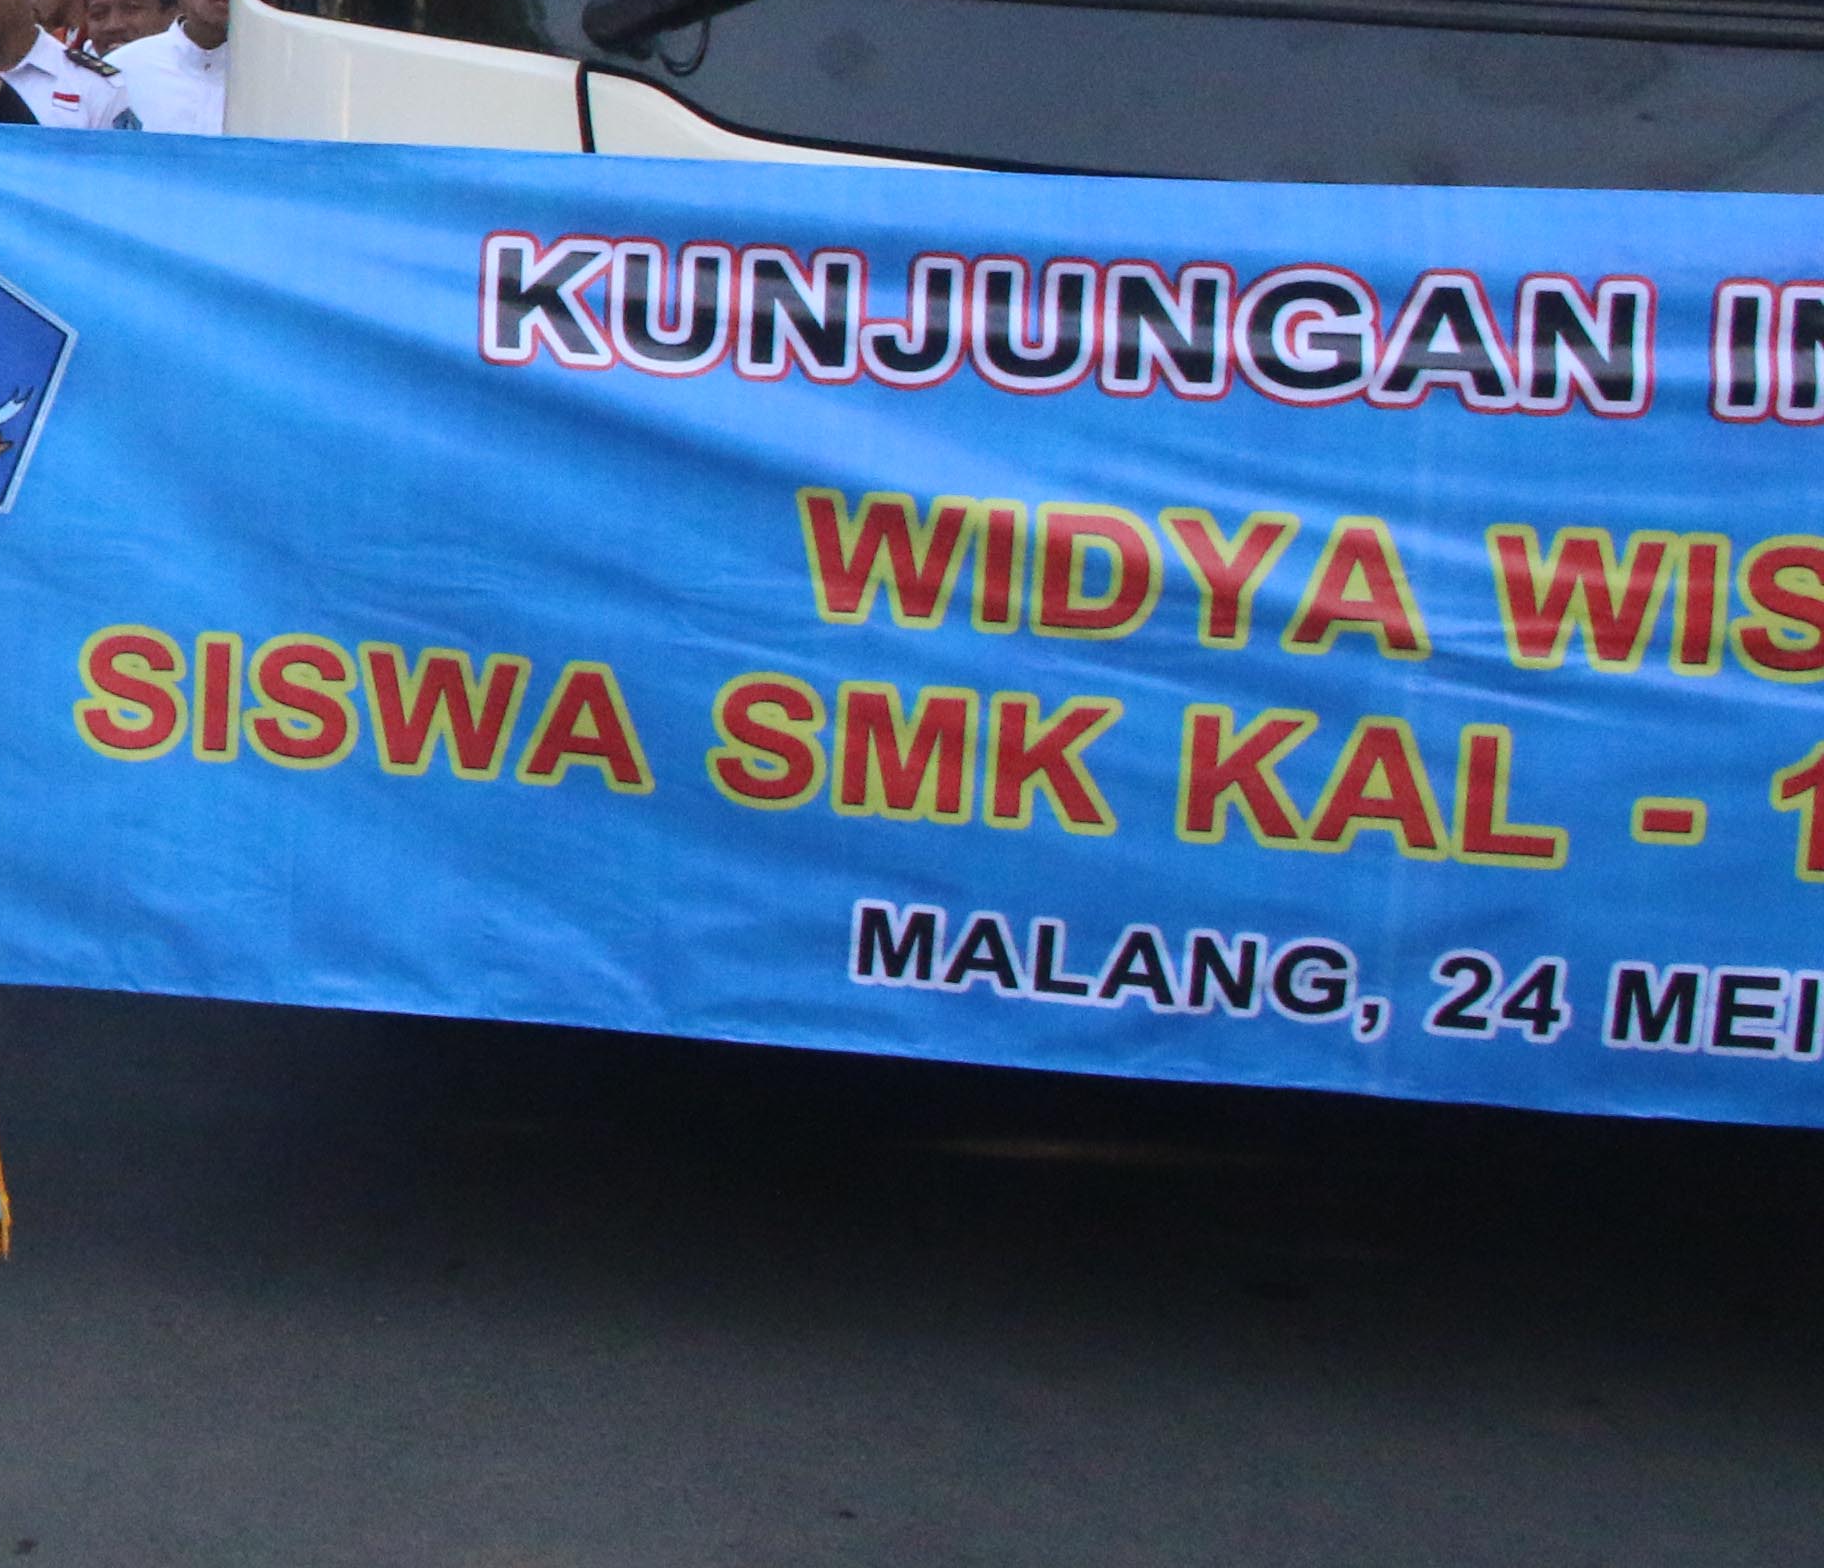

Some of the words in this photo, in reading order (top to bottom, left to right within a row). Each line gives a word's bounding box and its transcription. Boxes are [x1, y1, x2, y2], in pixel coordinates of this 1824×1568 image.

[480, 233, 1652, 416] KUNJUNGAN
[798, 487, 1432, 661] WIDYA
[1487, 523, 1824, 683] WIS
[74, 624, 655, 794] SISWA
[706, 671, 1123, 837] SMK
[1177, 703, 1568, 869] KAL
[1631, 796, 1707, 845] -
[851, 898, 1390, 1043] MALANG,
[1427, 946, 1571, 1041] 24
[1602, 958, 1824, 1063] MEI
